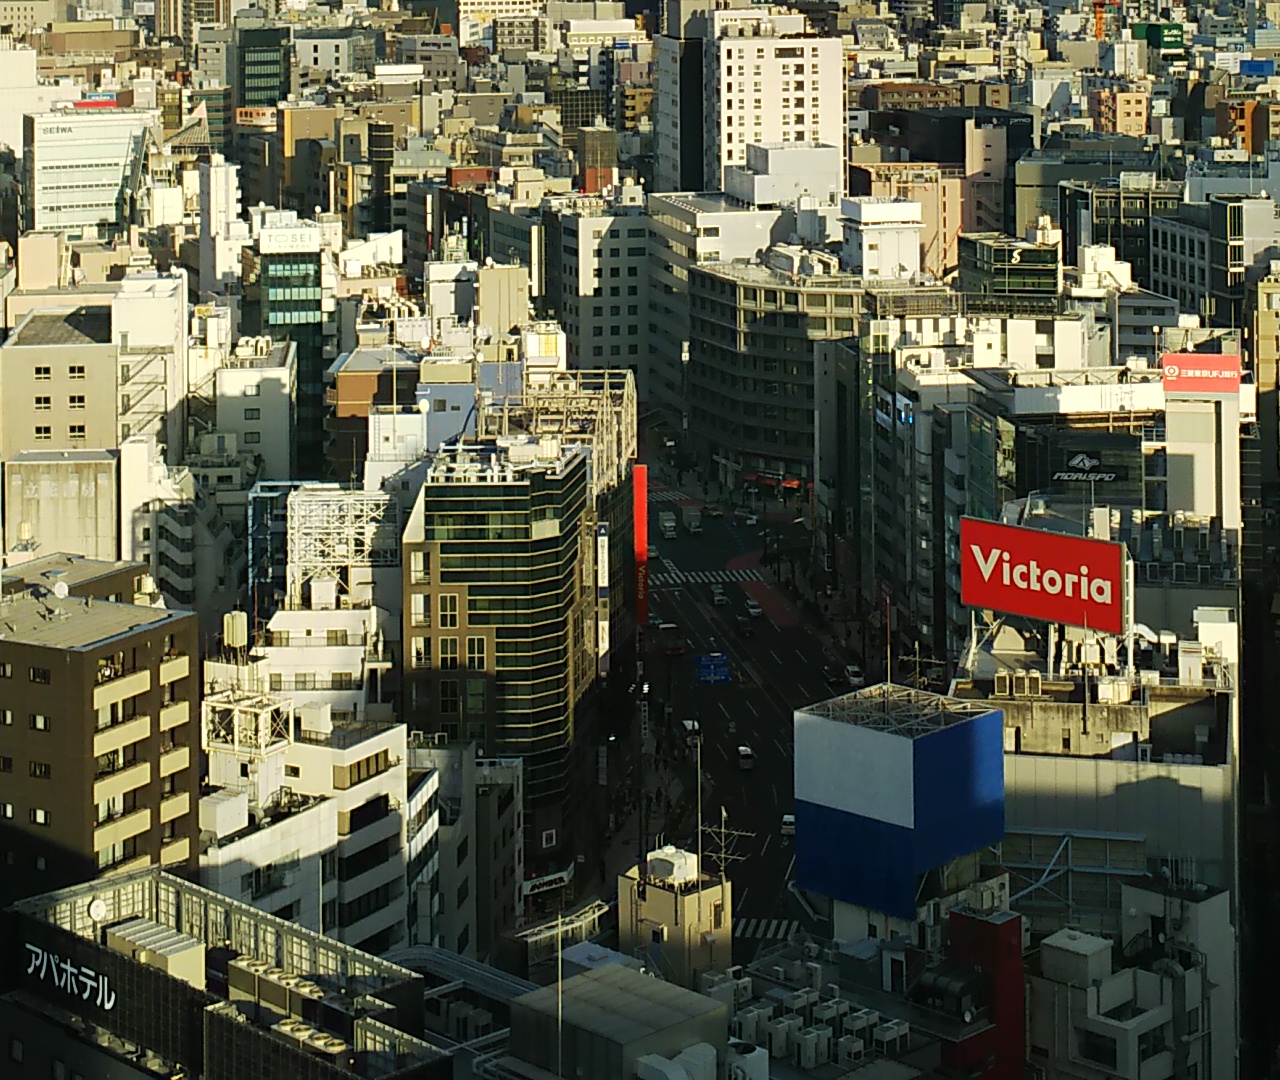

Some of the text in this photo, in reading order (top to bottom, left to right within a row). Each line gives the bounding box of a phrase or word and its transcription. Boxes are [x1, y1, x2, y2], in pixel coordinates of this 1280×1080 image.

[267, 234, 312, 243] TOSEI
[638, 565, 646, 599] Victoria
[970, 544, 1112, 605] Victoria
[25, 942, 116, 1010] アパホテル
